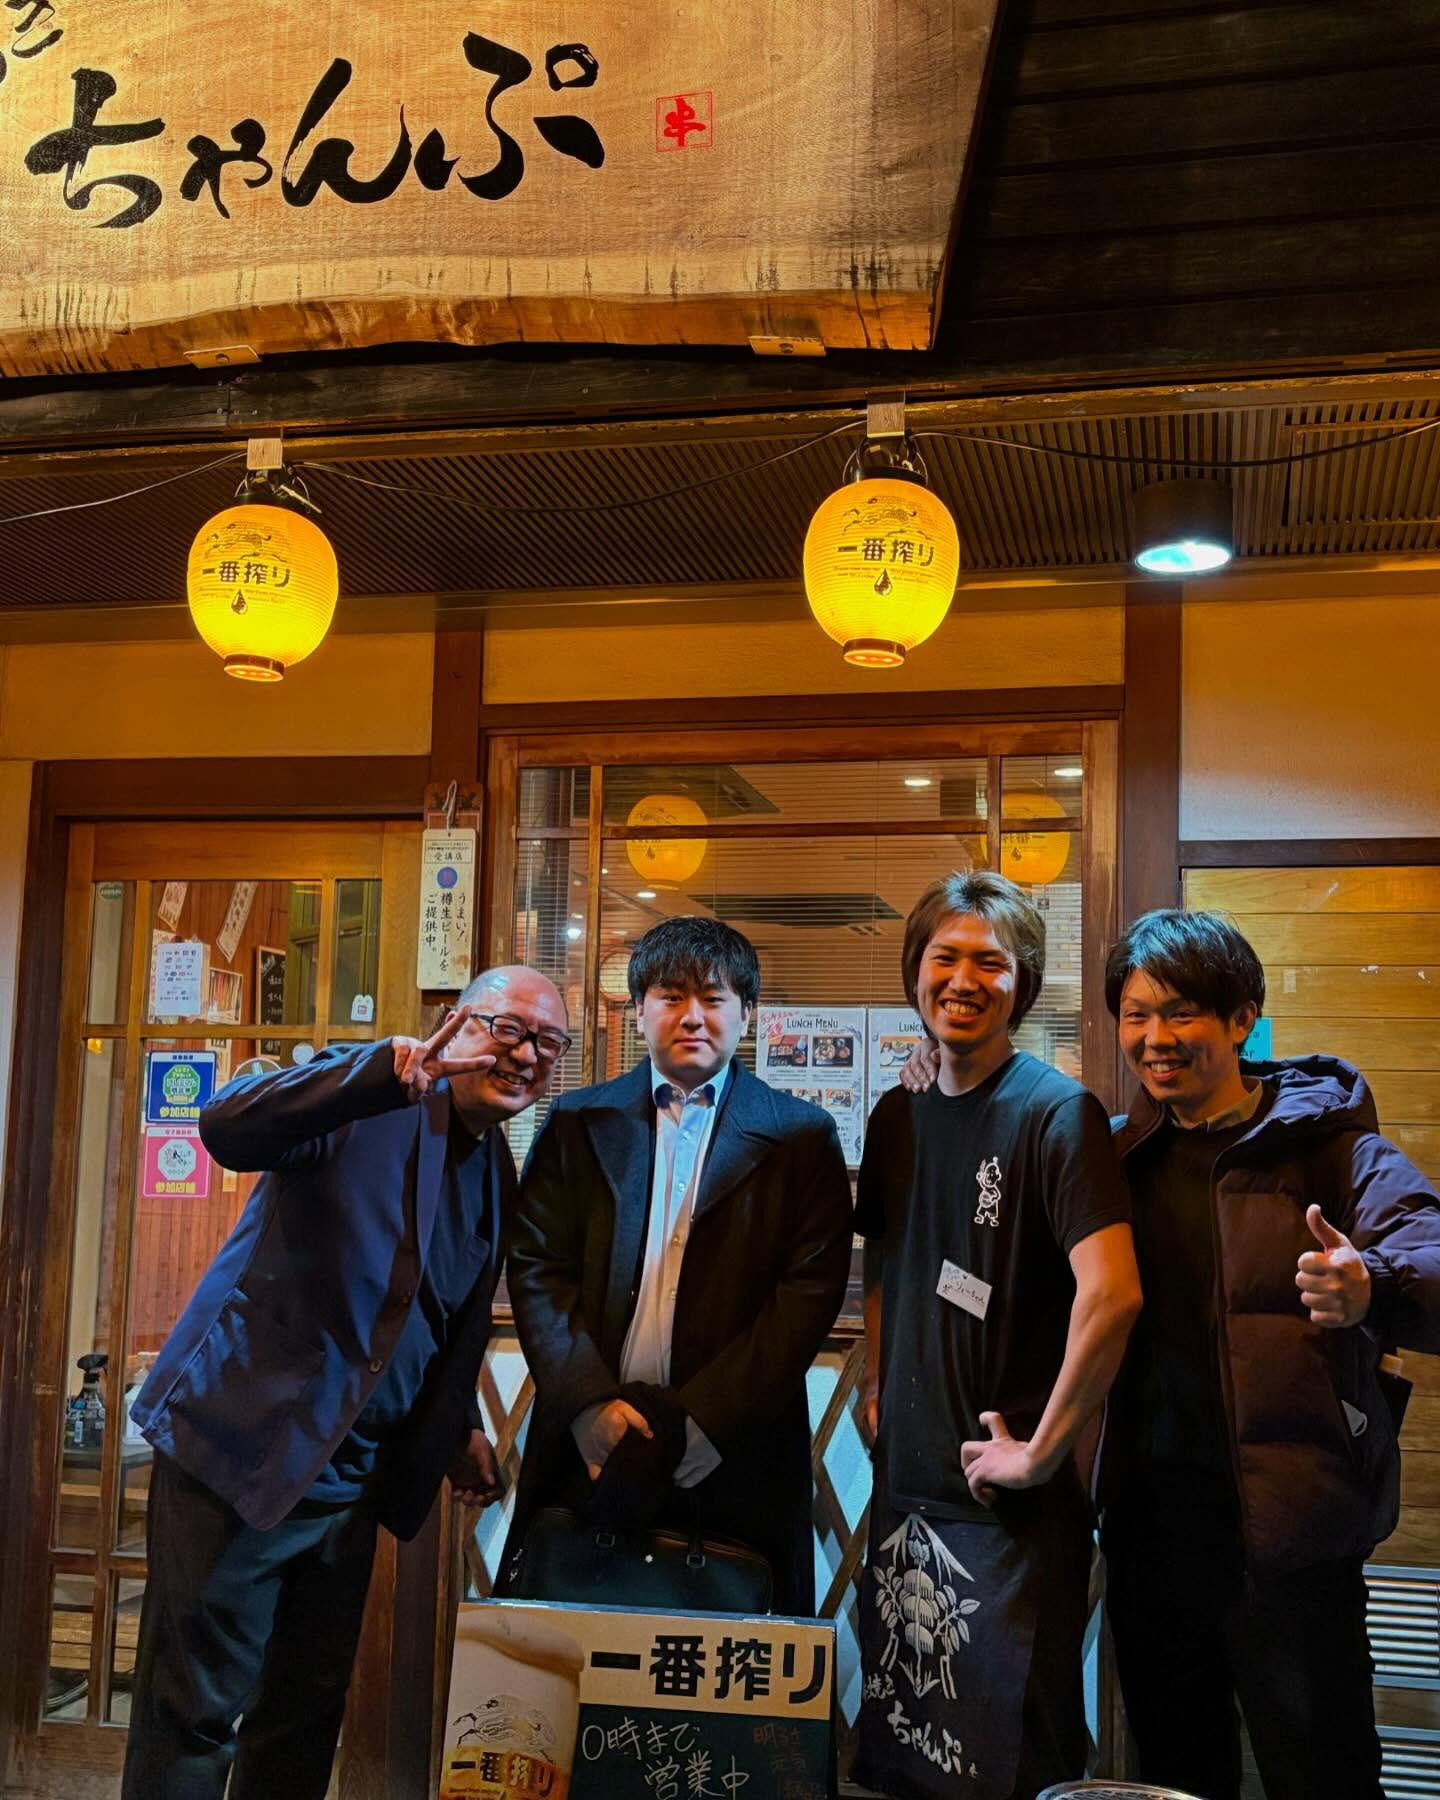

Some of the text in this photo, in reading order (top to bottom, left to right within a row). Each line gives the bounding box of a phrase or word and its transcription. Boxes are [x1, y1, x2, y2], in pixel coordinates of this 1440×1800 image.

[24, 32, 605, 228] ちゃんぷ
[202, 561, 291, 588] 一番搾り
[837, 538, 934, 566] 一番搾り
[439, 892, 452, 972] 樽生ビールを
[590, 1634, 826, 1704] 一番搾り
[582, 1706, 700, 1761] 0時まで
[887, 1700, 962, 1775] ちゃんぷ
[451, 1751, 554, 1798] 一番搾り
[644, 1750, 750, 1800] 営業中
